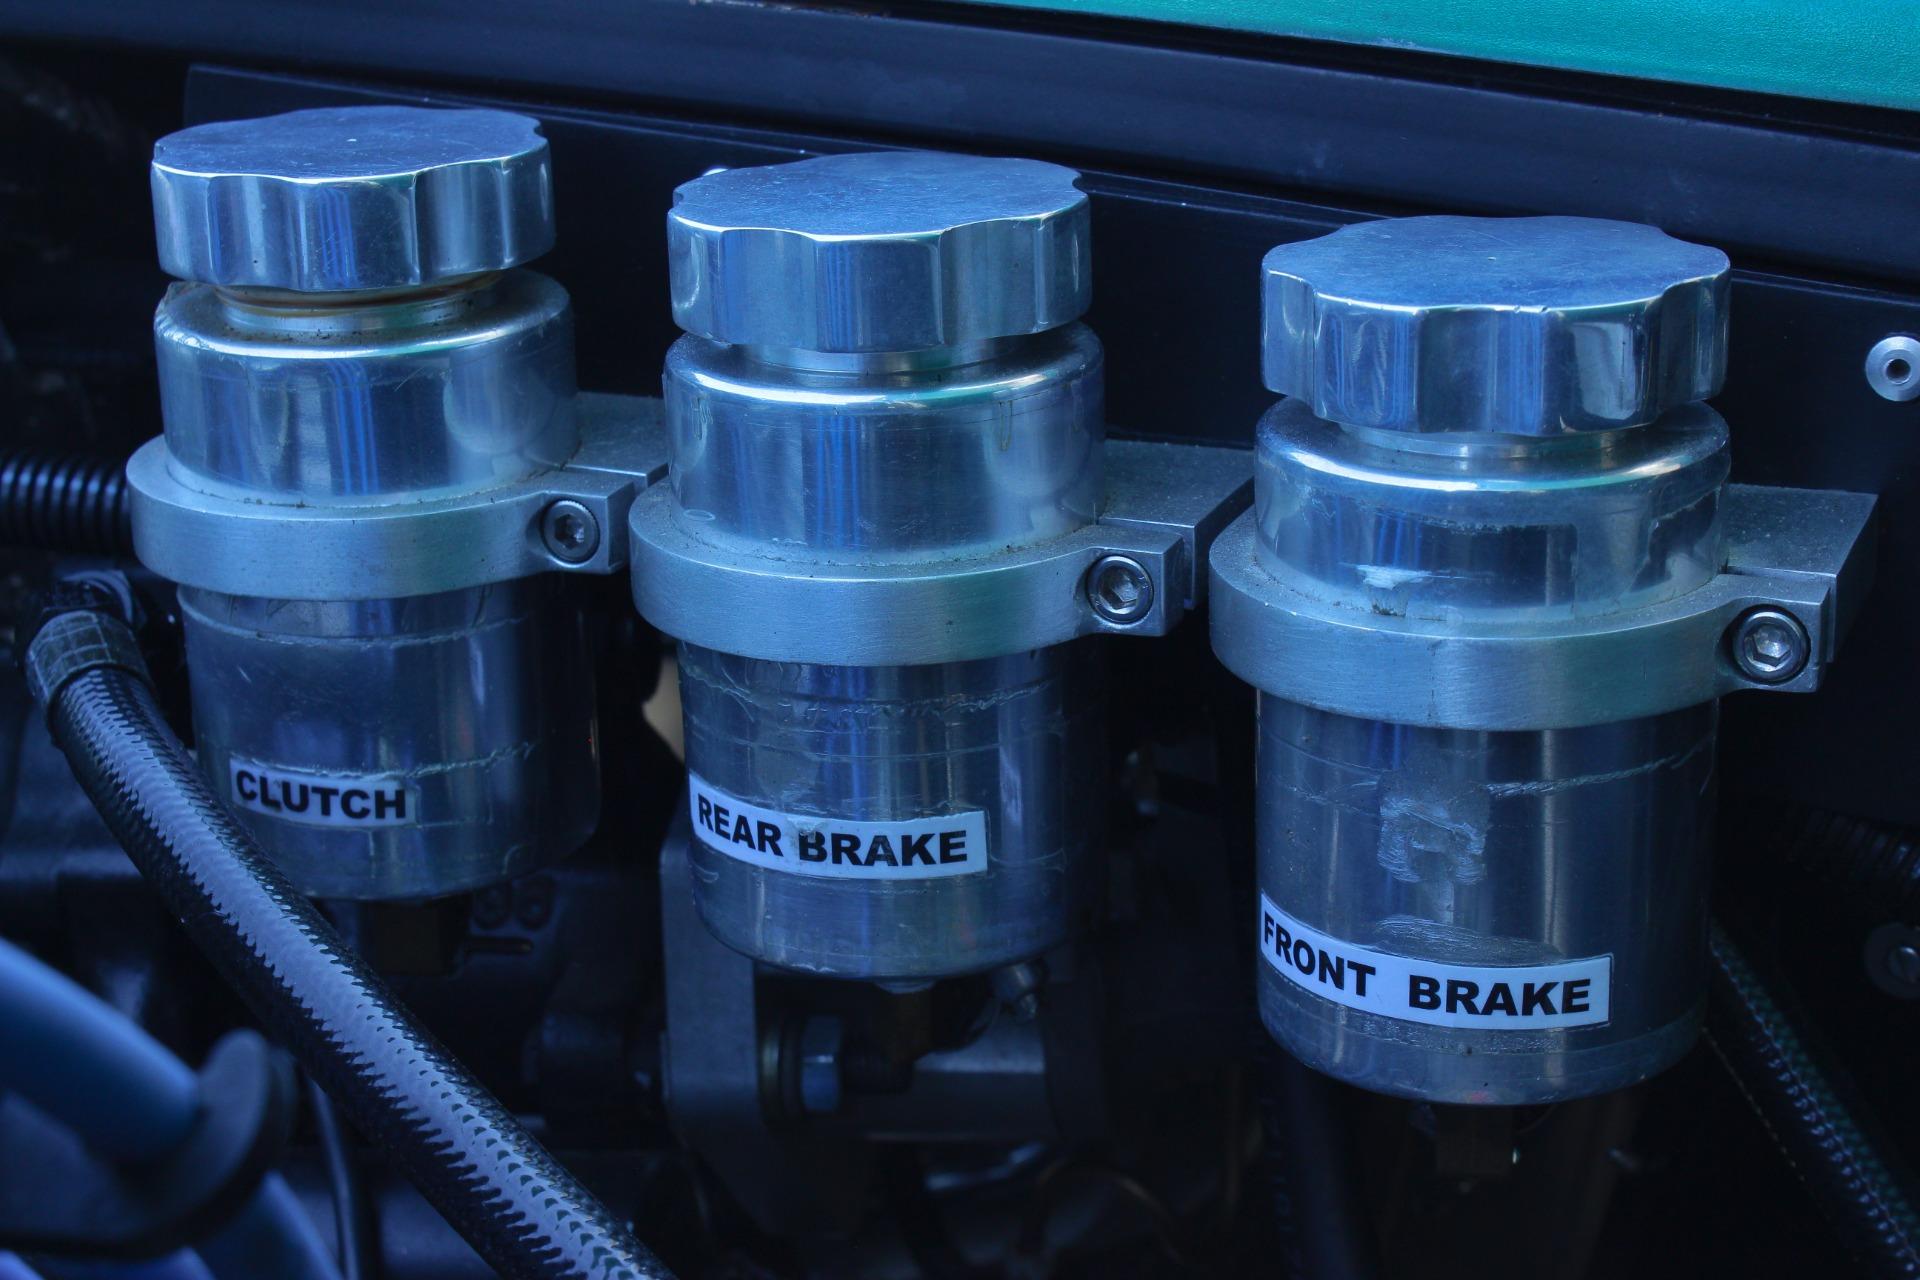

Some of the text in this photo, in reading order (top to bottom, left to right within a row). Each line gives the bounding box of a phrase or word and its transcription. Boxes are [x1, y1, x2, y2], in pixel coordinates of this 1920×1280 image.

[236, 770, 406, 819] CLUTCH
[698, 793, 967, 867] REAR BRAKE
[1264, 911, 1591, 1016] FRONT BRAKE
